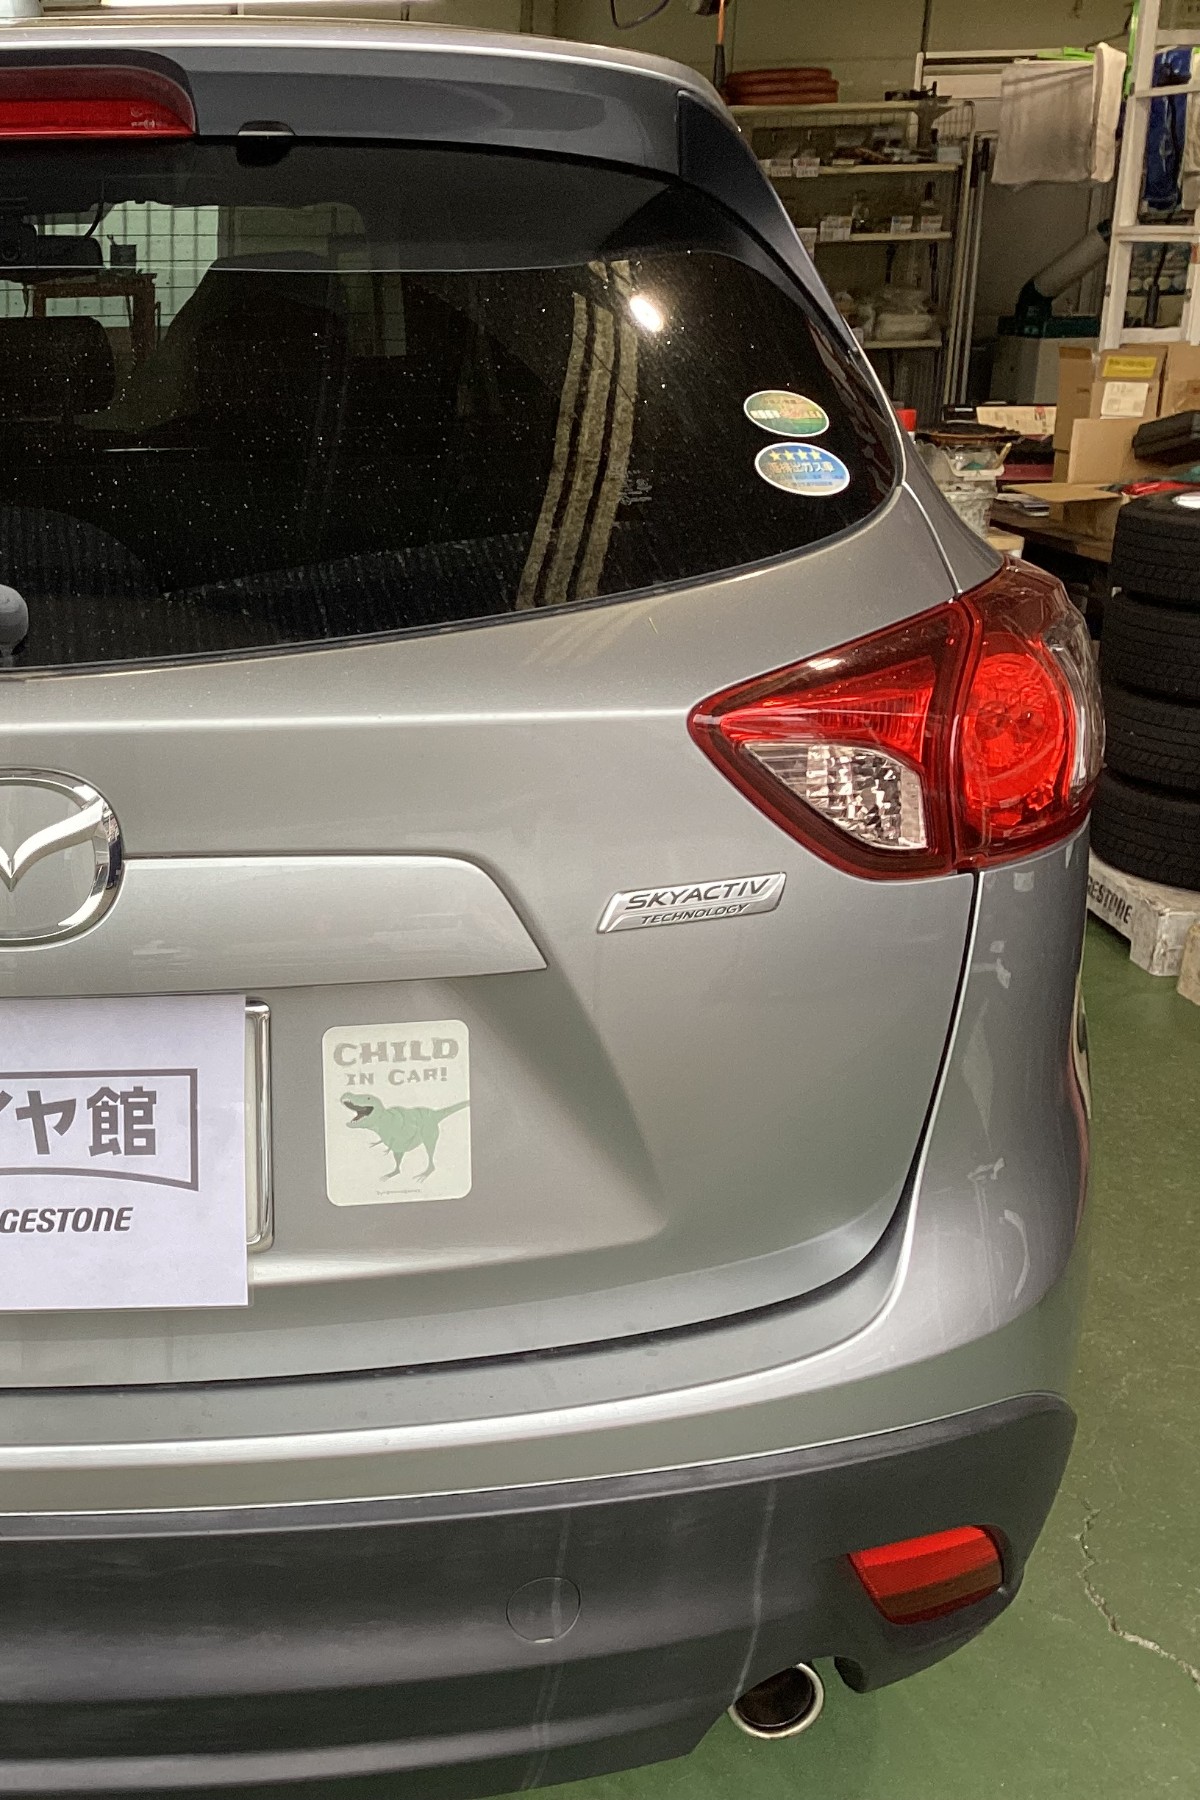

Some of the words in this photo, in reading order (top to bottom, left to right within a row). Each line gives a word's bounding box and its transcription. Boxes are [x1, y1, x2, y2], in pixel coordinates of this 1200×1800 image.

[625, 878, 770, 911] SKYACTIV
[641, 903, 750, 925] TECHNOLOGY
[333, 1037, 459, 1067] CHILD
[345, 1072, 375, 1087] IN
[388, 1066, 448, 1086] CAR!
